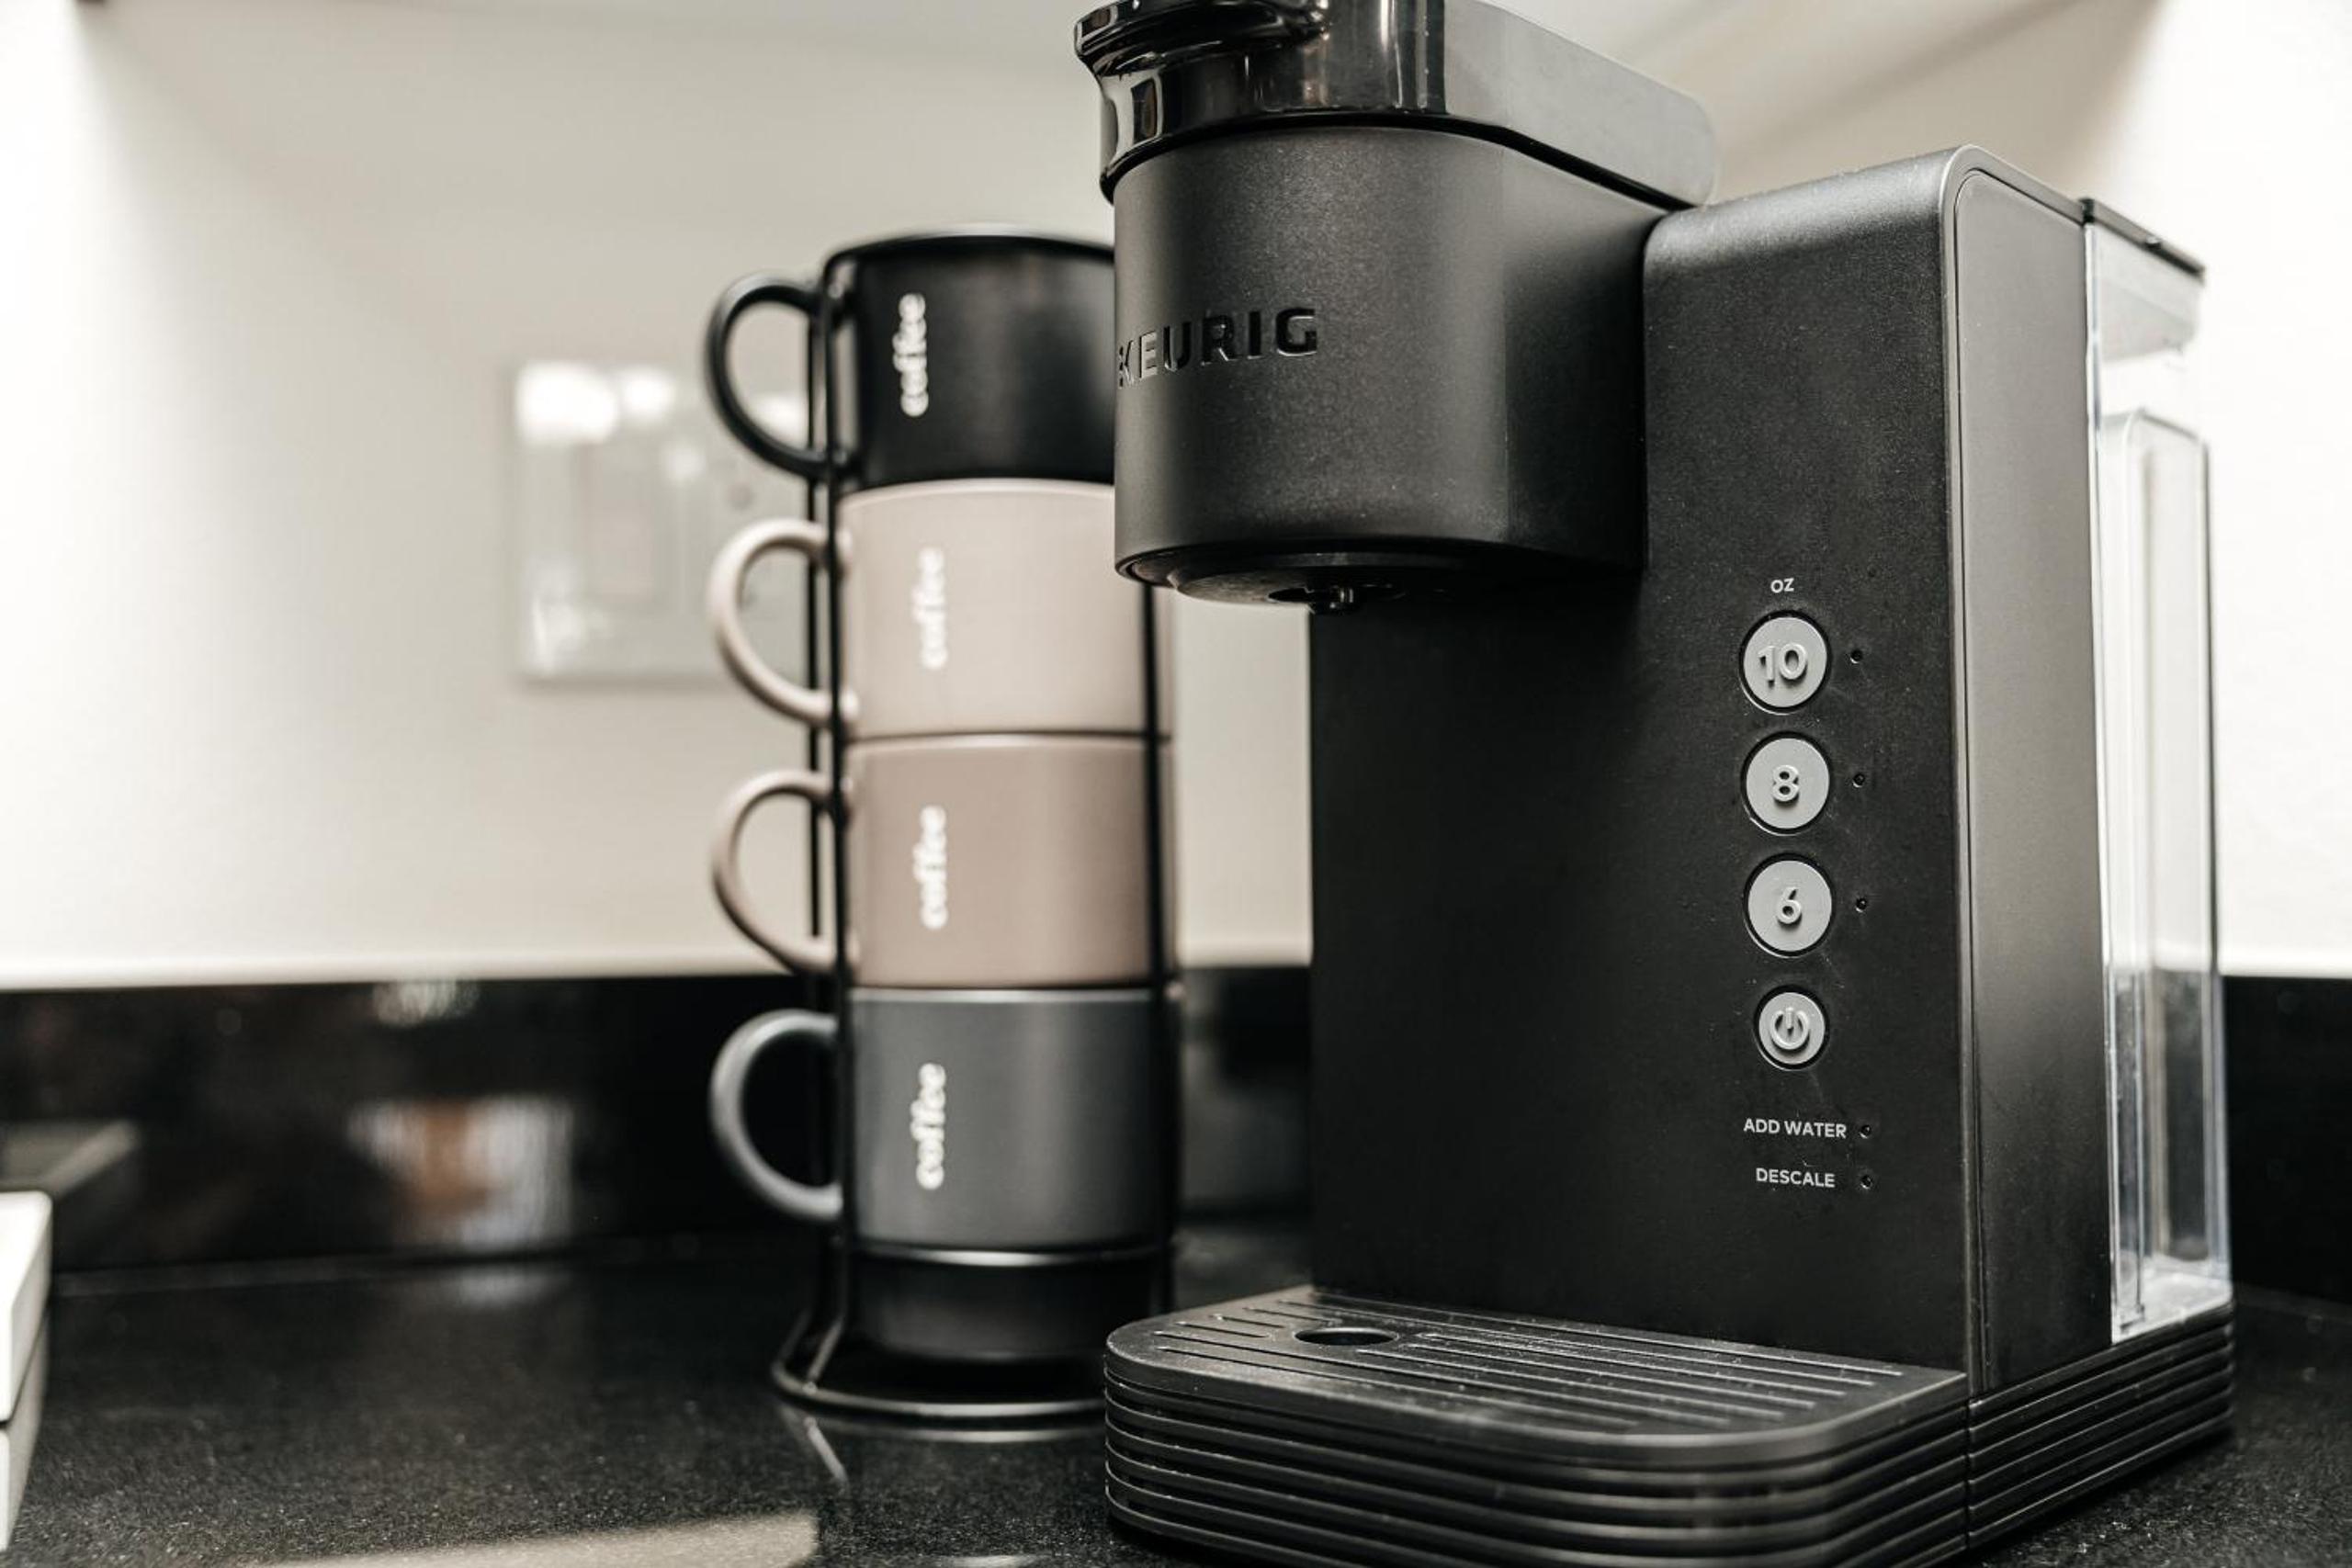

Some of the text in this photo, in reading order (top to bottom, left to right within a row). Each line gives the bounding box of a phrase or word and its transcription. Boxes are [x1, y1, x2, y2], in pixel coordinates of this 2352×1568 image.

[1117, 308, 1317, 389] KEURIG
[1770, 578, 1794, 593] OZ
[1758, 643, 1808, 687] 10
[1771, 764, 1800, 805] 8
[1776, 887, 1803, 927] 6
[1743, 1117, 1848, 1139] ADD WATER
[1755, 1168, 1836, 1189] DESCALE
